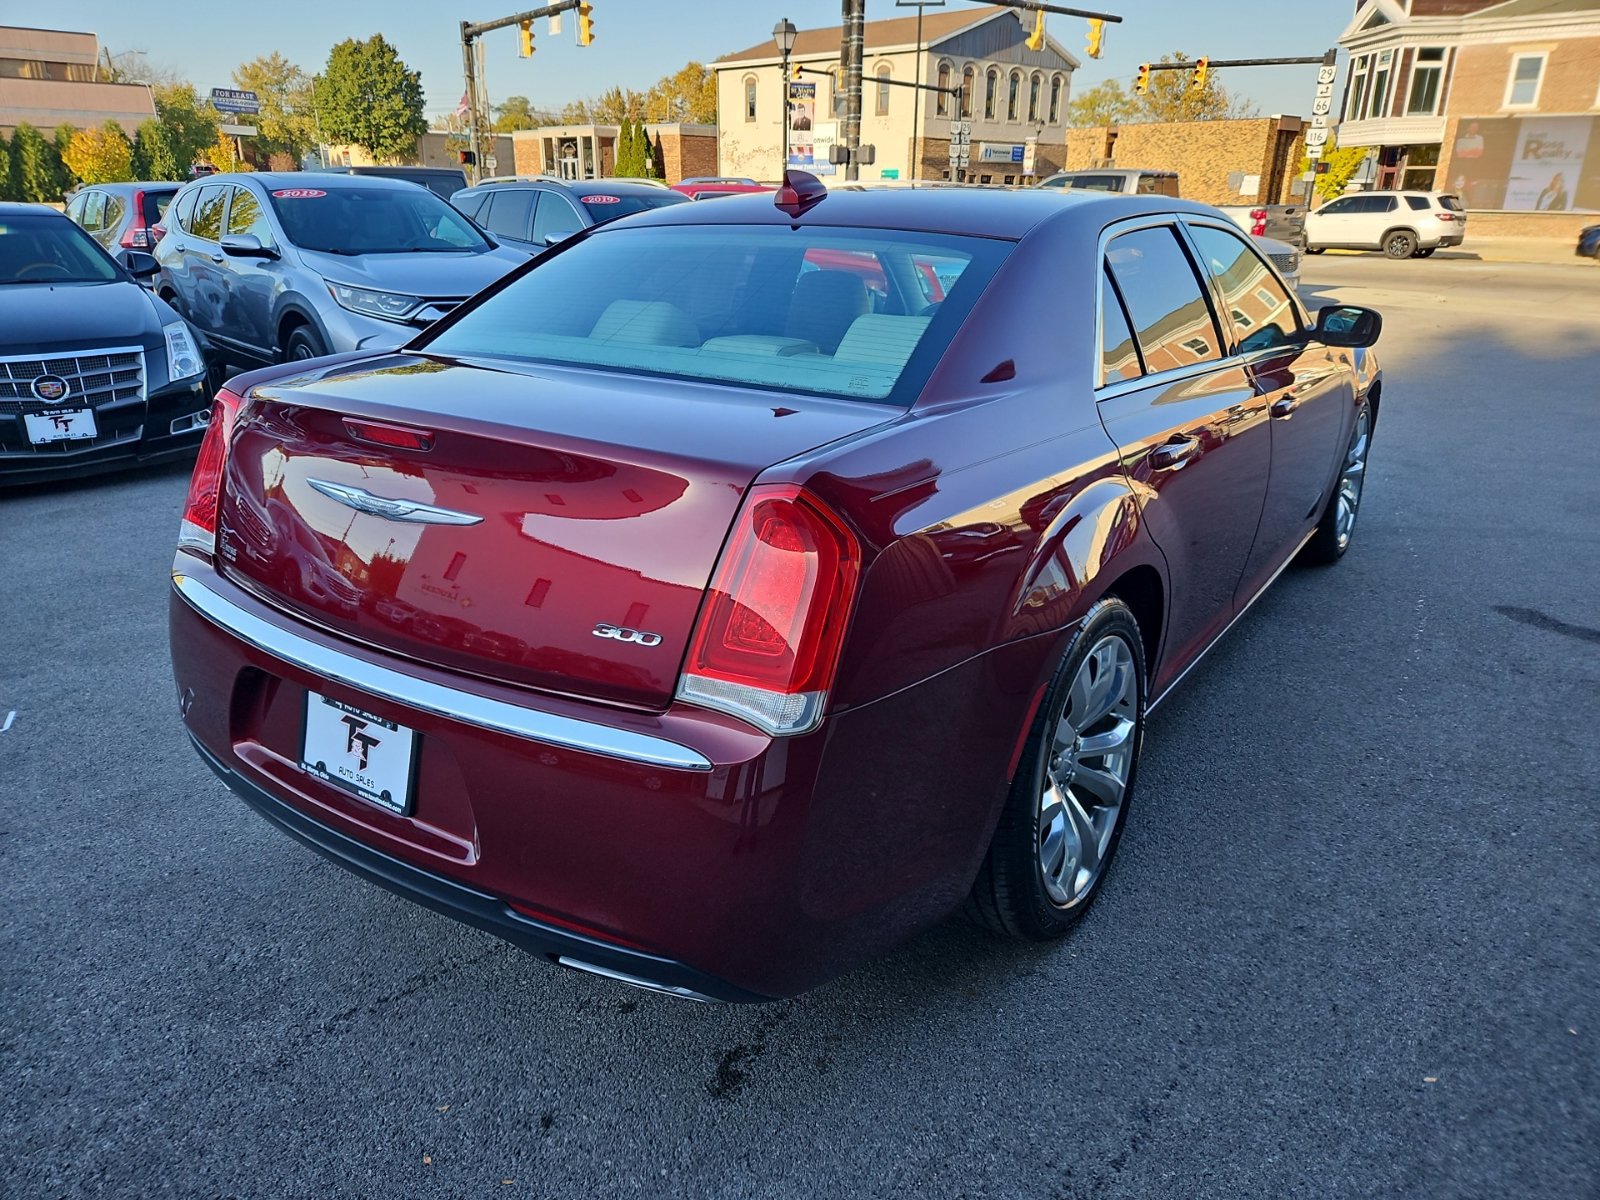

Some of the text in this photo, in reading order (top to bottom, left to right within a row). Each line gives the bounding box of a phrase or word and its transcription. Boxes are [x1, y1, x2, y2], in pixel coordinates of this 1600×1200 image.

[1320, 69, 1333, 80] 29
[215, 90, 254, 100] FOR LEASE
[1315, 101, 1328, 111] 66
[962, 123, 971, 132] 29
[1309, 132, 1323, 141] 116
[961, 146, 969, 155] 66
[283, 190, 318, 198] 2019
[592, 623, 663, 647] 300
[338, 765, 375, 788] AUTO SALES
